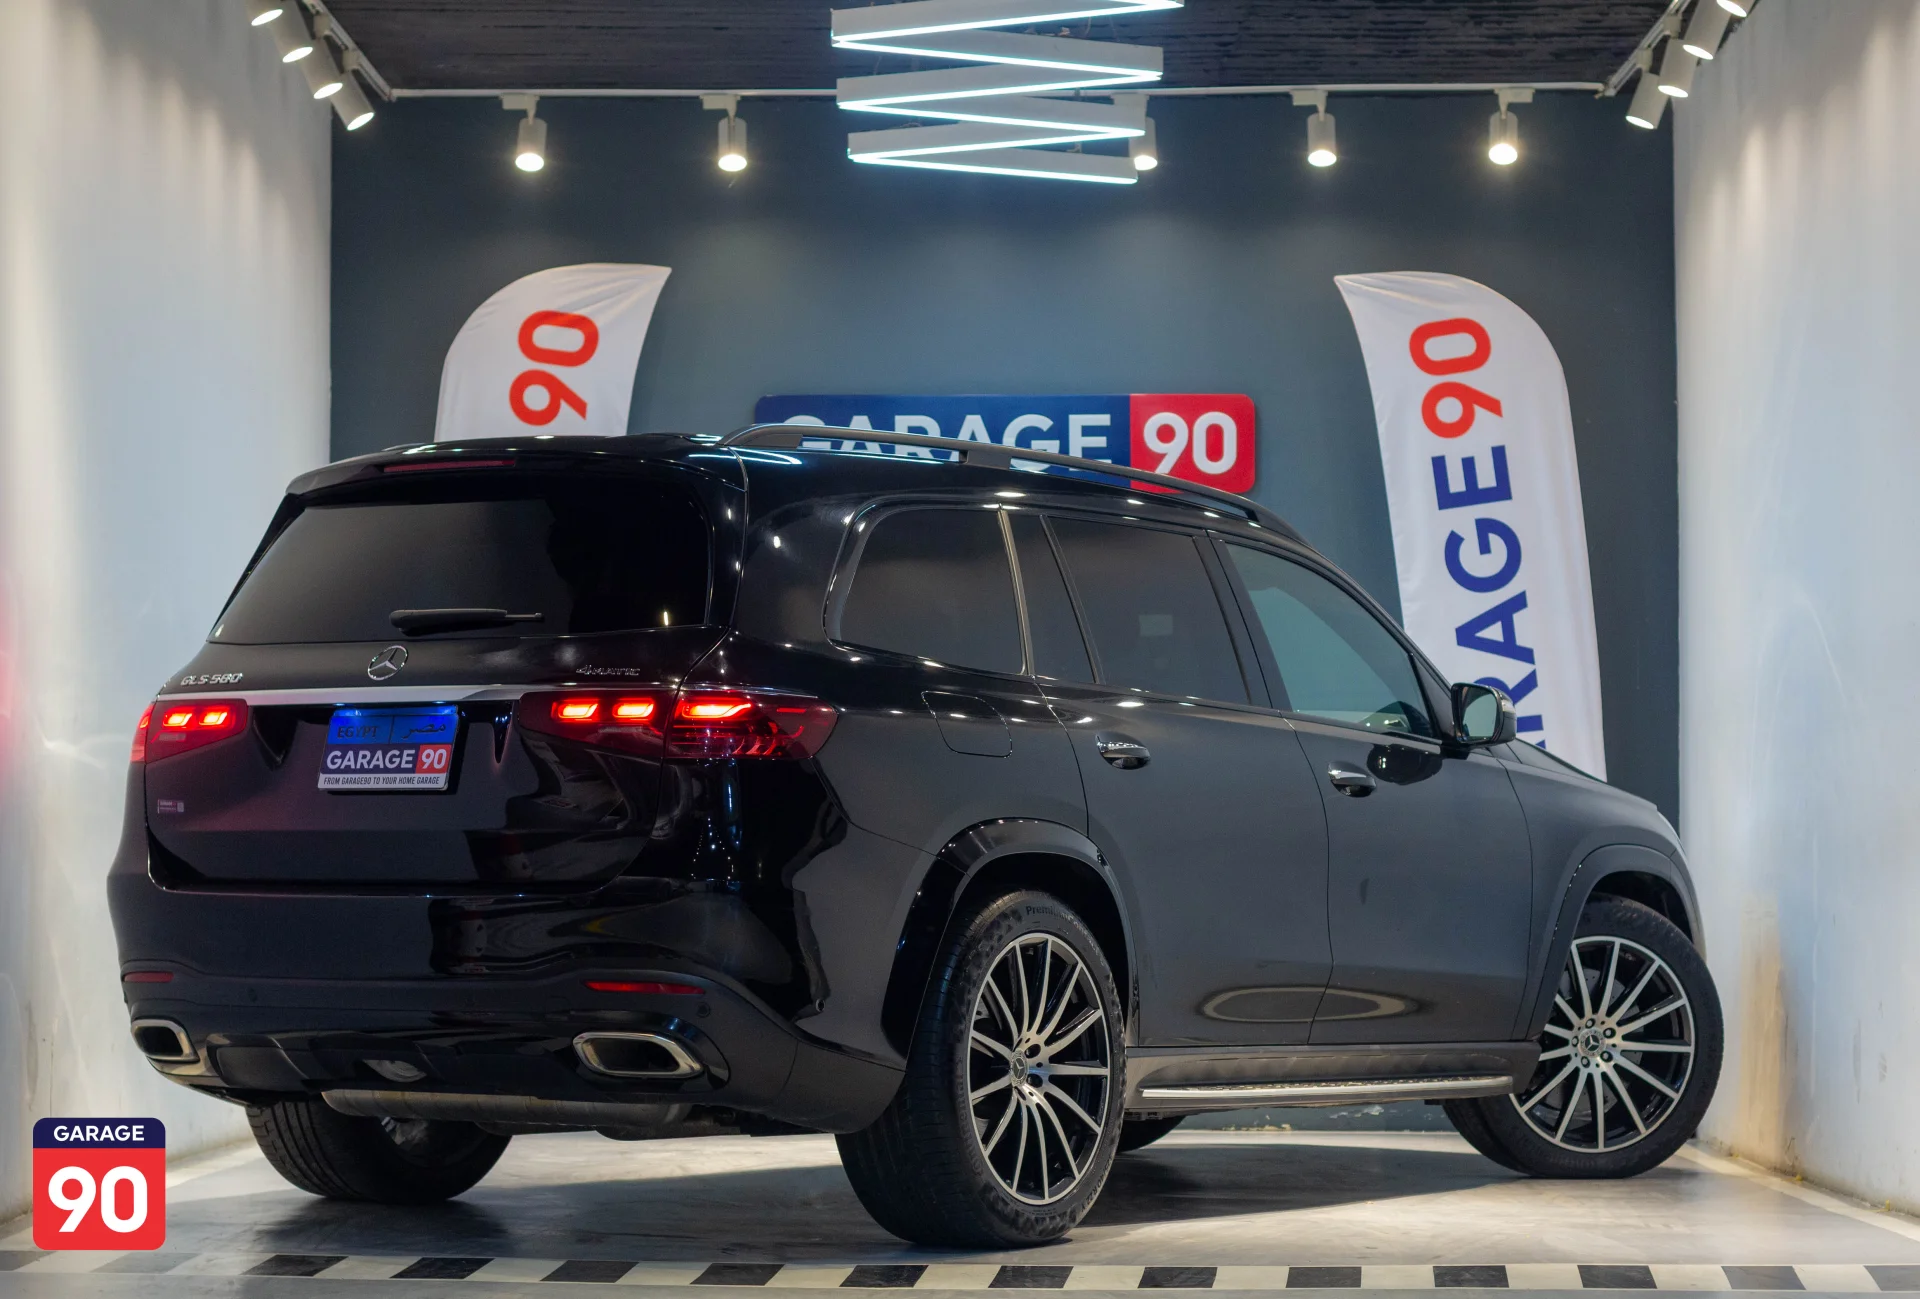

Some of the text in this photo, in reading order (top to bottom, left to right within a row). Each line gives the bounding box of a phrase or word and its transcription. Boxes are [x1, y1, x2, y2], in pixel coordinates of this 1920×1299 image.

[509, 310, 599, 426] 90
[1143, 411, 1238, 474] 90
[1409, 317, 1547, 750] RAGE 90
[180, 674, 209, 686] GLS
[337, 726, 379, 739] EGYPT
[401, 723, 447, 740] مصر
[326, 748, 448, 770] GARAGE 90
[323, 776, 440, 785] FROM GARAGE90 TO YOUR HOME GARAGE
